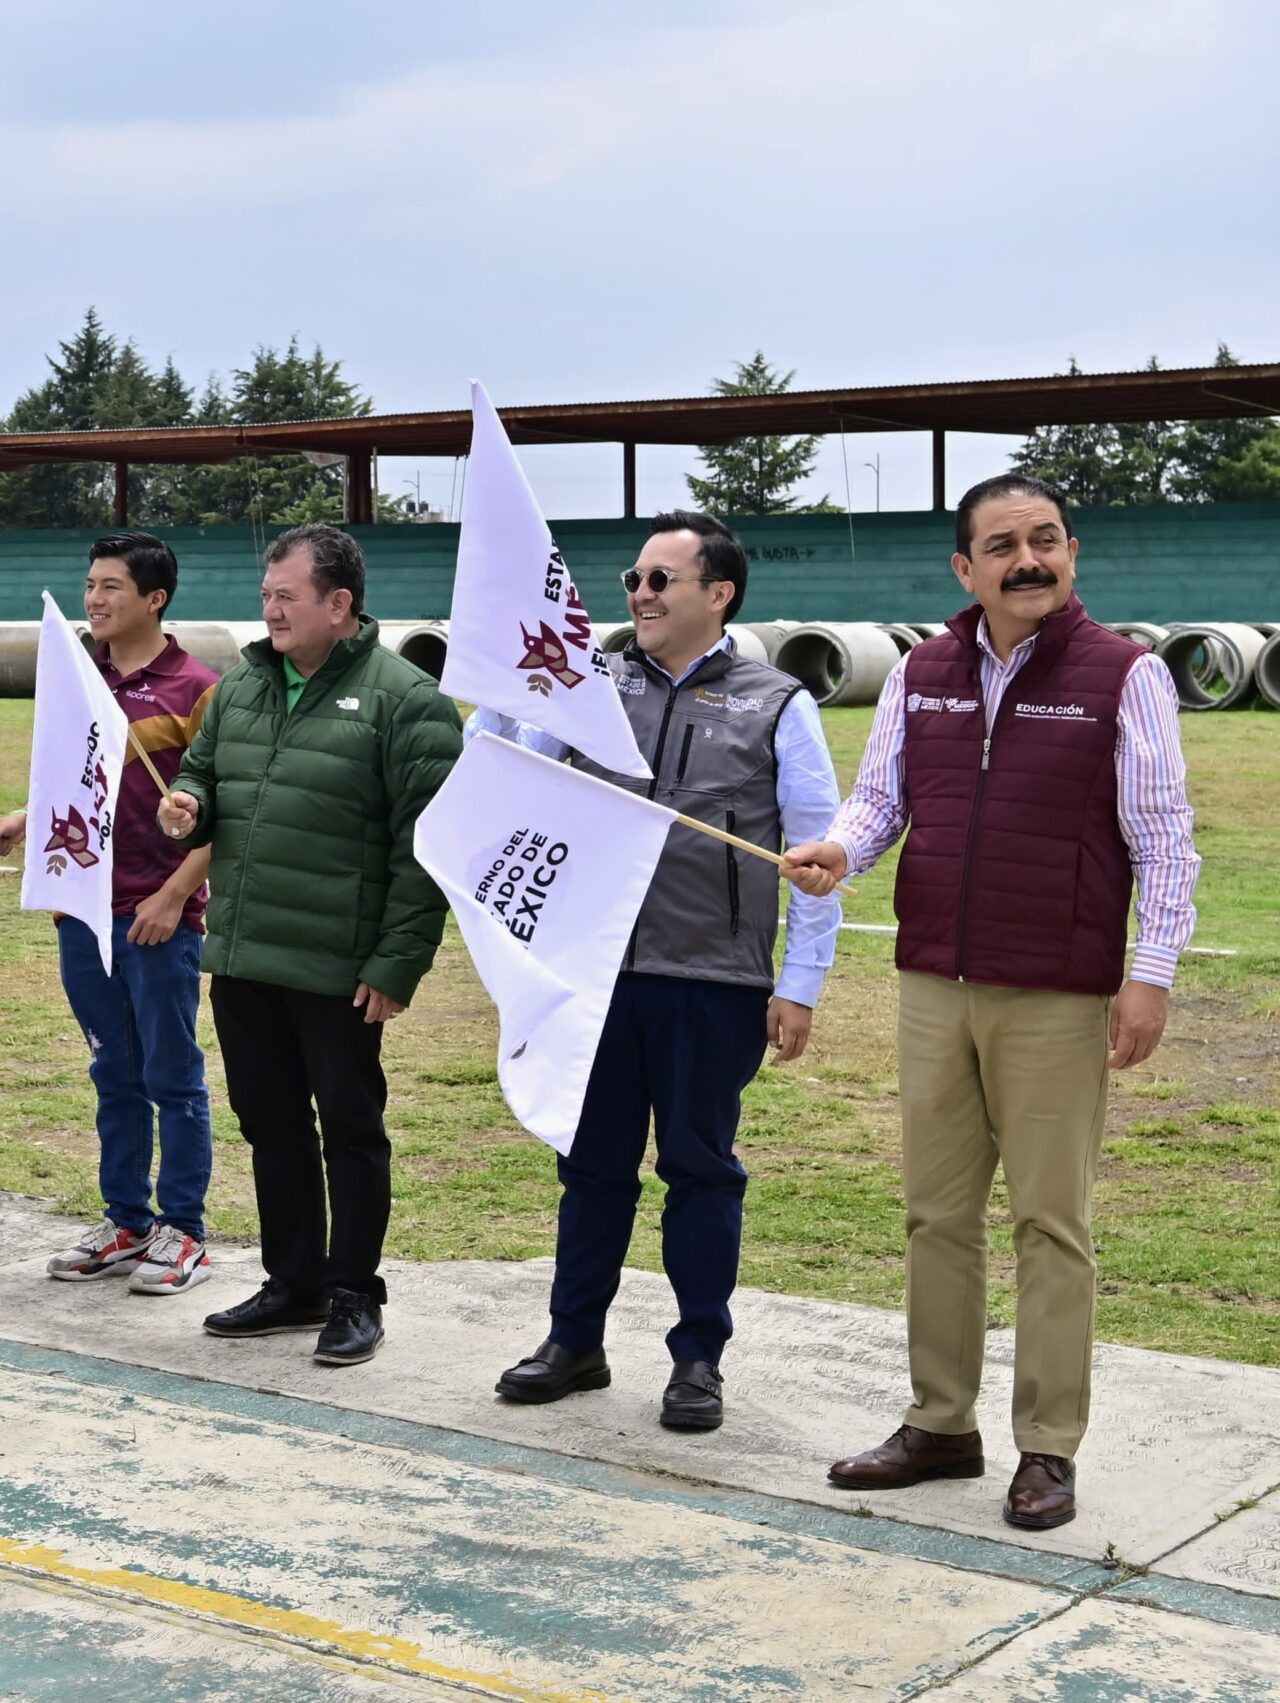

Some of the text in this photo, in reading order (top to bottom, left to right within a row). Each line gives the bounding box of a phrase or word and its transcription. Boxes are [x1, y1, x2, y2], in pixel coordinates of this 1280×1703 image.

[544, 551, 564, 603] ESTA
[1015, 703, 1084, 716] EDUCACIÓN
[474, 828, 529, 904] ERNO DEL
[492, 832, 548, 917] ADO DE
